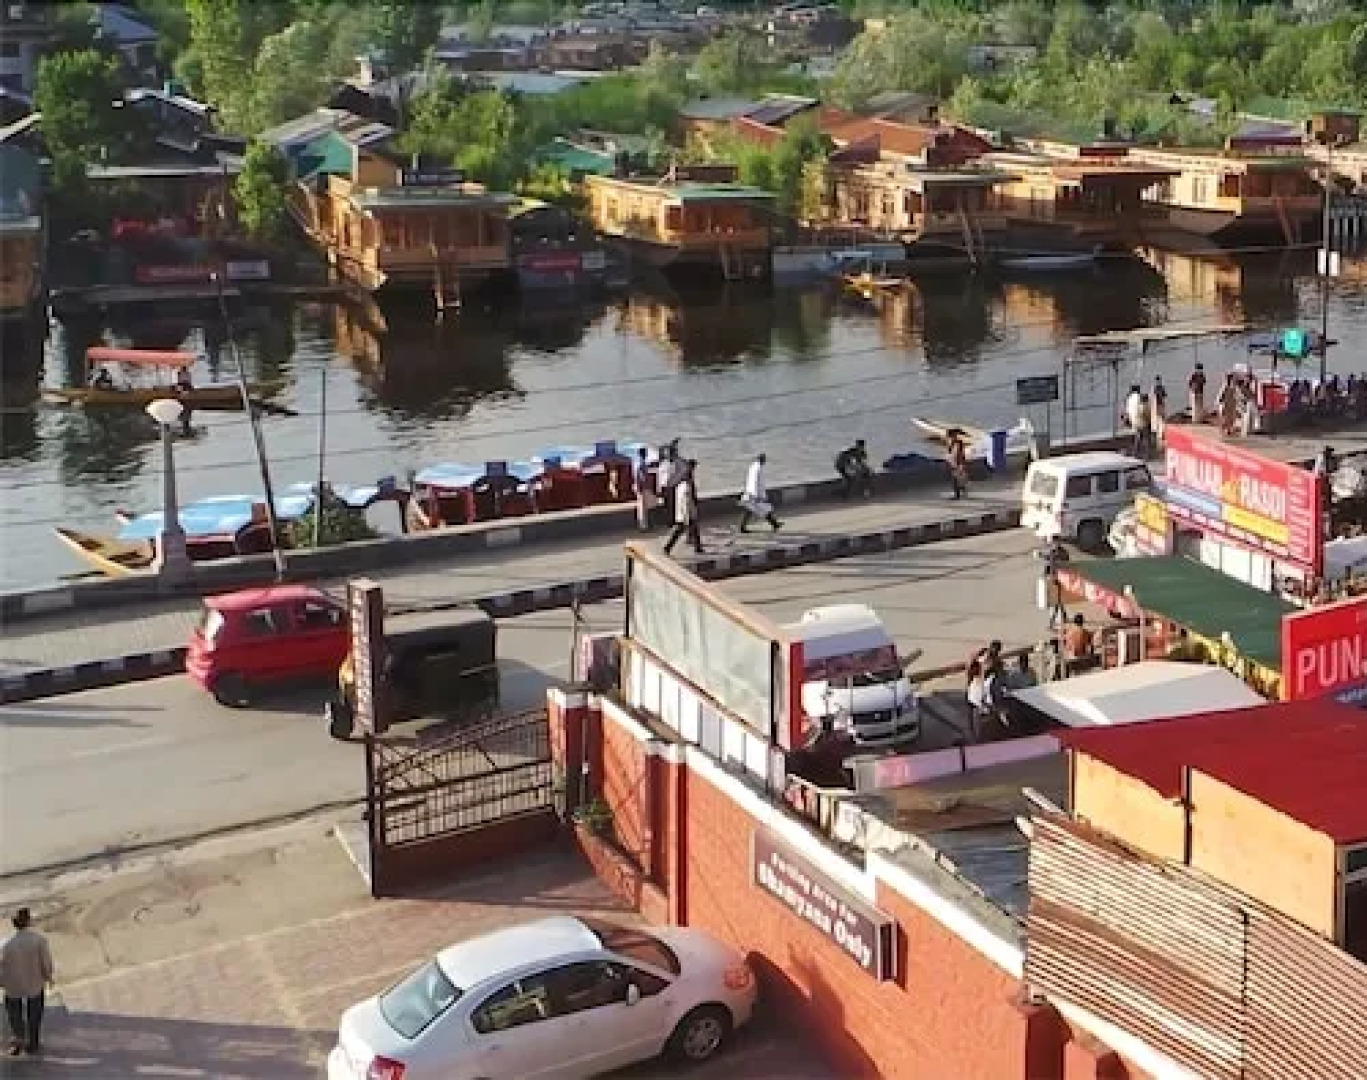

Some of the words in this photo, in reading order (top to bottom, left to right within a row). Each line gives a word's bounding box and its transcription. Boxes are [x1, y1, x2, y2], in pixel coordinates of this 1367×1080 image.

[1167, 448, 1223, 499] PUNJAB
[1240, 474, 1286, 522] RASOI
[834, 919, 872, 968] Only
